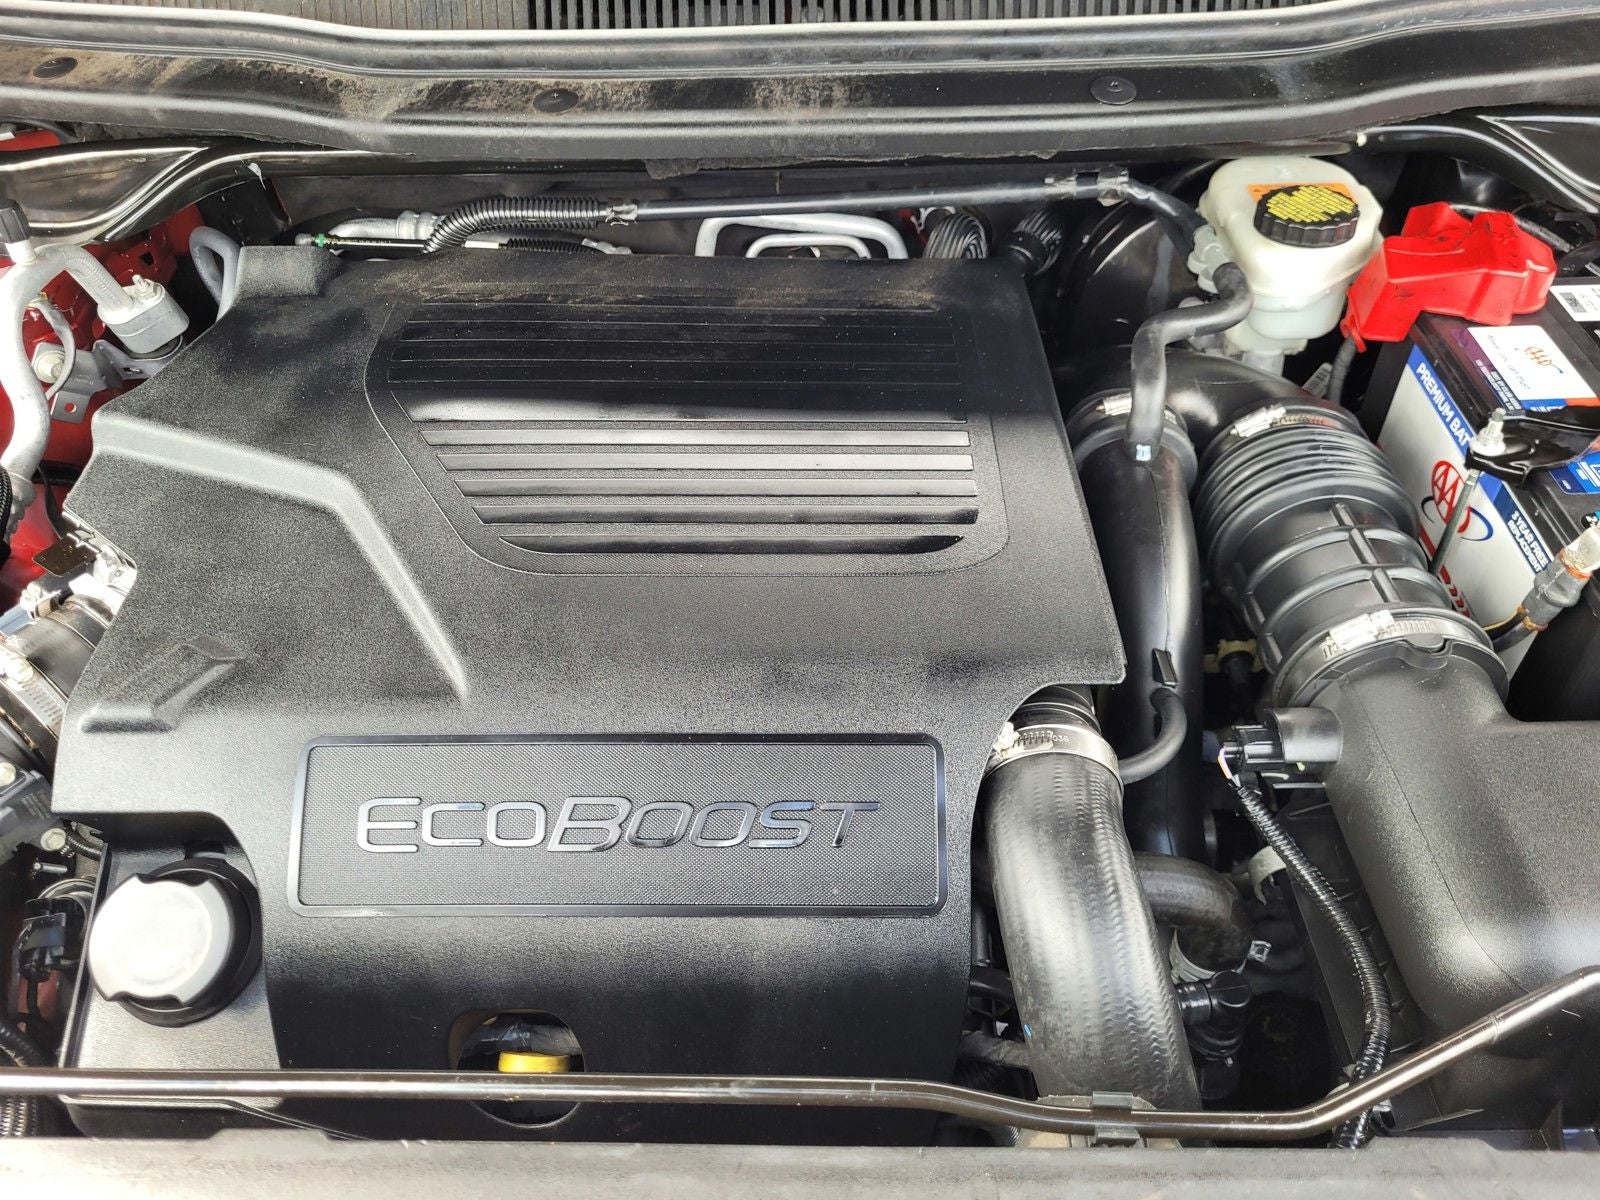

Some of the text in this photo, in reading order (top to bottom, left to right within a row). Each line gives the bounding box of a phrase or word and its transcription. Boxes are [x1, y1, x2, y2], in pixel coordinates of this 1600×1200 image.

[1416, 362, 1455, 423] PREMIUM
[1507, 519, 1542, 572] REPLACEMENT
[1511, 510, 1550, 568] 3 YEAR FREE
